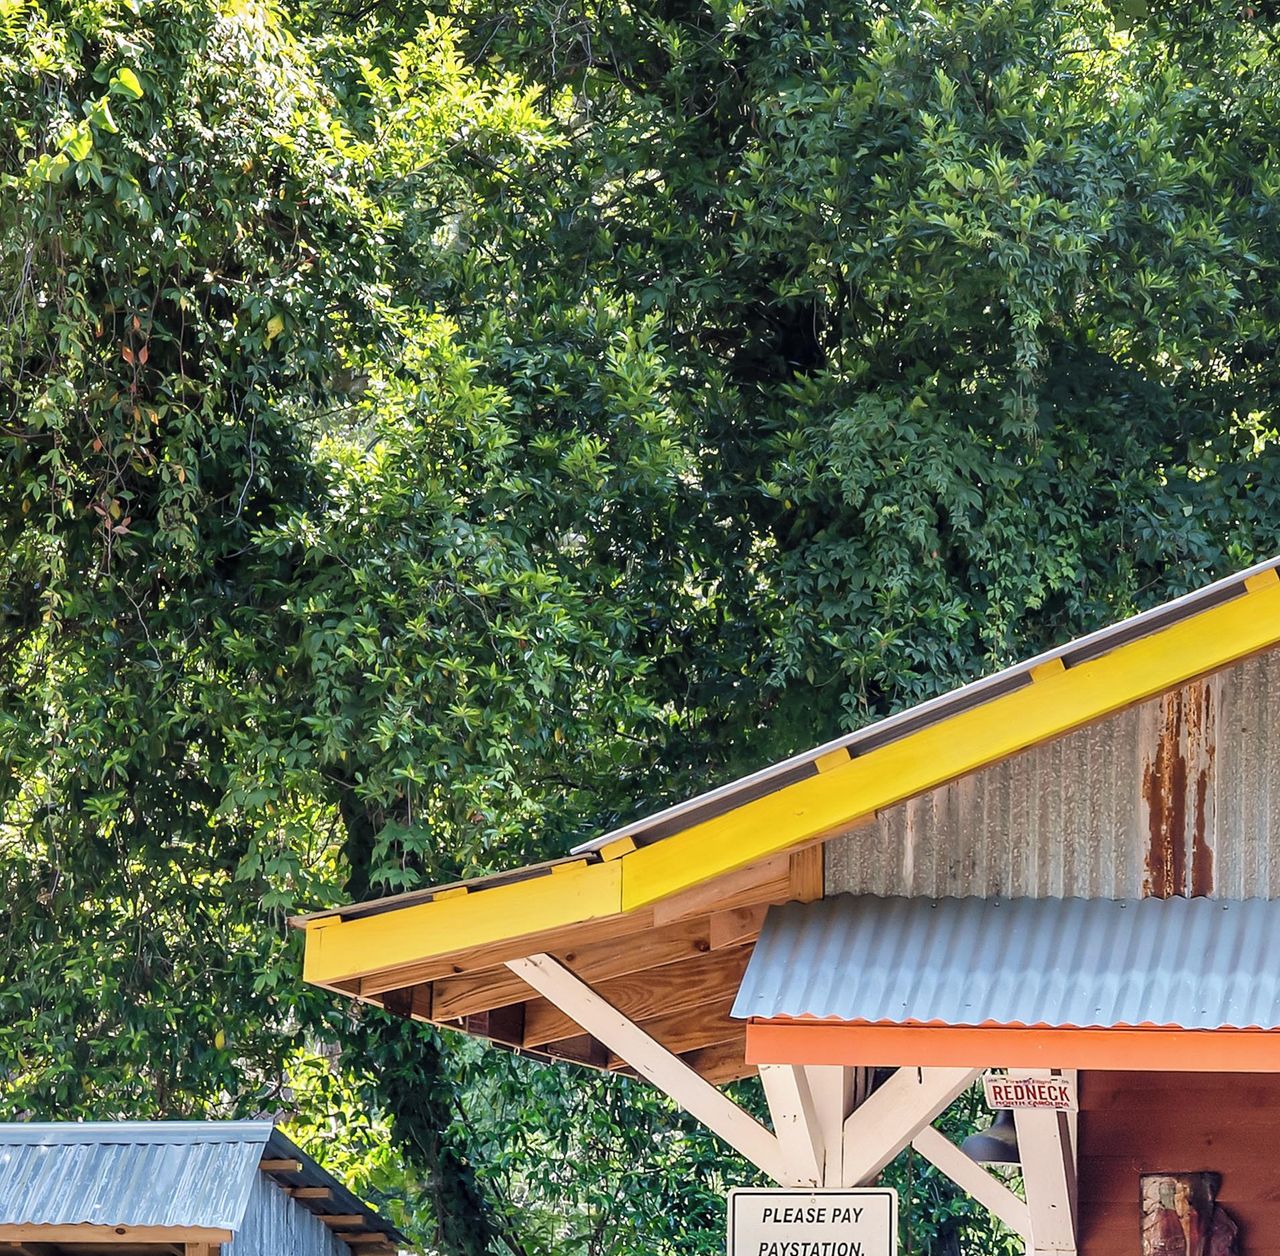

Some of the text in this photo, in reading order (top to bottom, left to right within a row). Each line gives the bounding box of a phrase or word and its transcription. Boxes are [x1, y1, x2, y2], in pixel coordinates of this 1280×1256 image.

[992, 1085, 1070, 1102] REDNECK
[762, 1208, 864, 1223] PLEASE PAY
